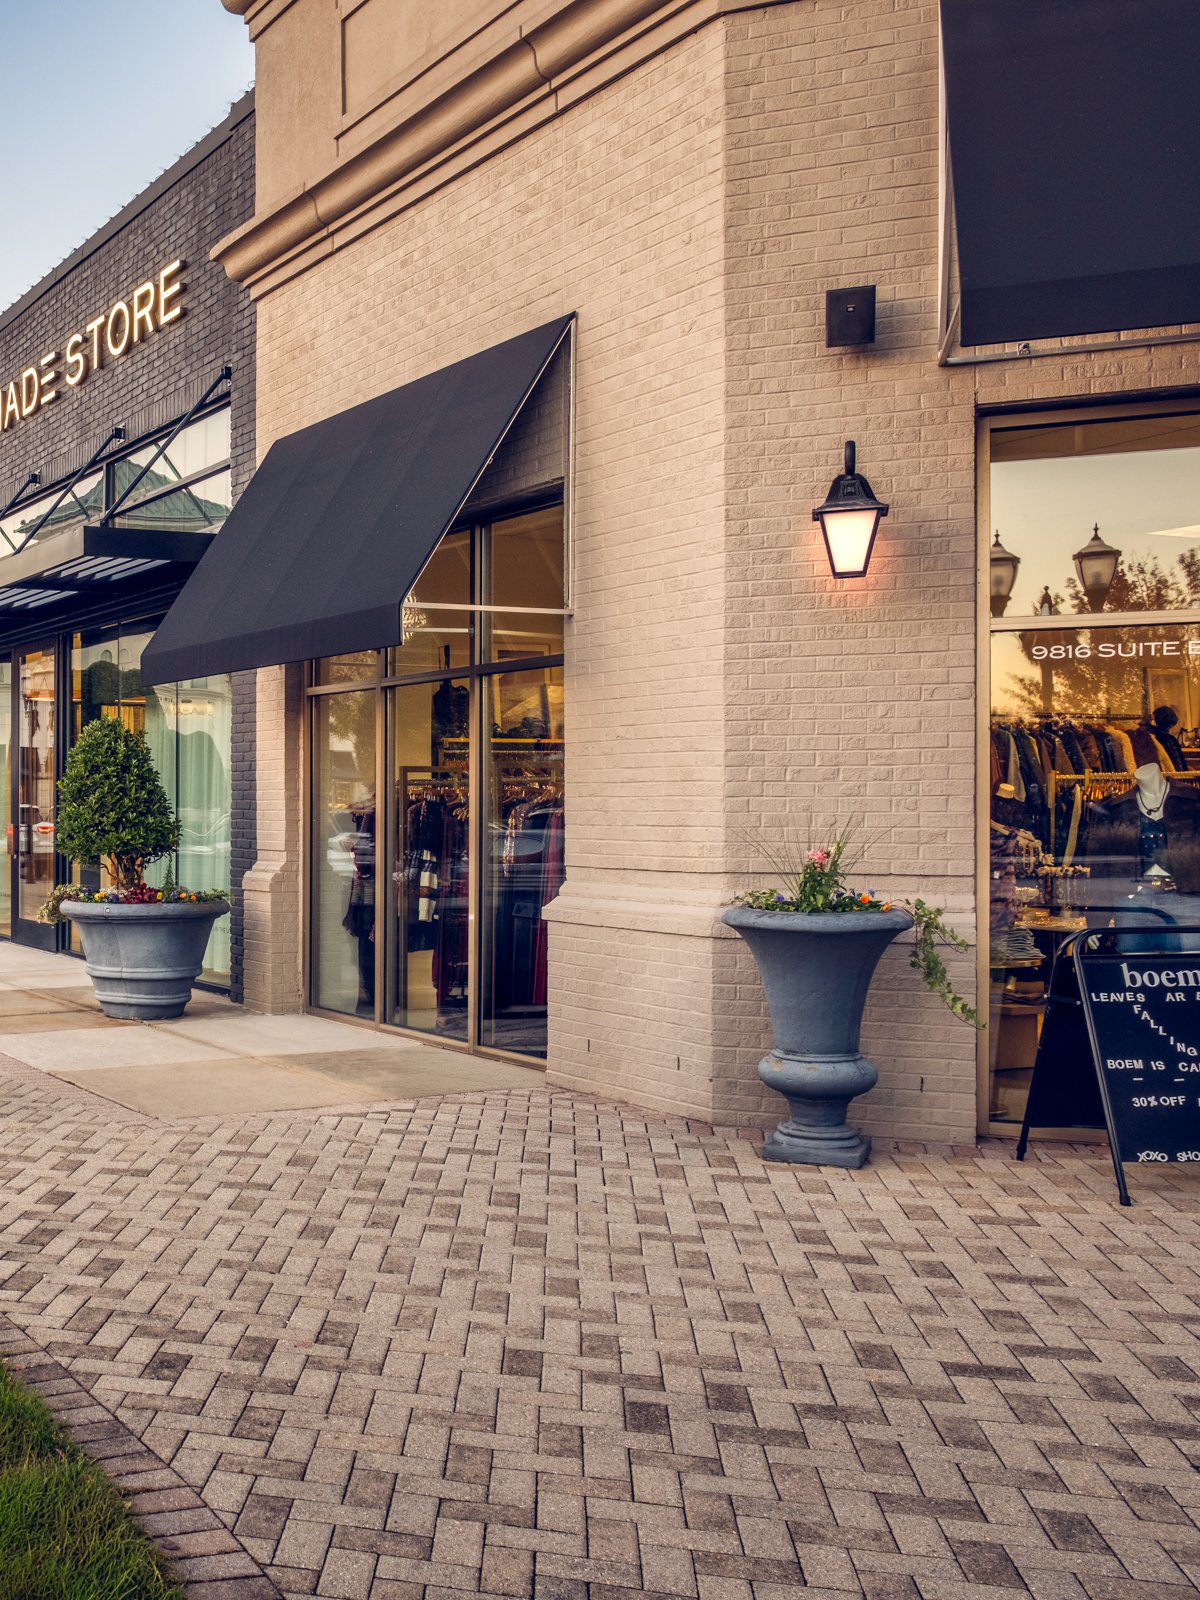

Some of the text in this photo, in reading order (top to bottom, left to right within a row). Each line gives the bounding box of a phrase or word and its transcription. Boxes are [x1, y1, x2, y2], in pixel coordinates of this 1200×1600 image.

[66, 258, 184, 386] STORE
[1032, 645, 1091, 660] 9816
[1098, 641, 1181, 658] SUITE
[1120, 963, 1200, 988] boem
[1091, 992, 1146, 1003] LEAVES
[1133, 1004, 1198, 1057] FALLING
[1107, 1059, 1200, 1073] BOEM IS CA
[1132, 1095, 1158, 1108] 30%
[1160, 1095, 1186, 1107] OFF
[1137, 1150, 1169, 1163] XOXO
